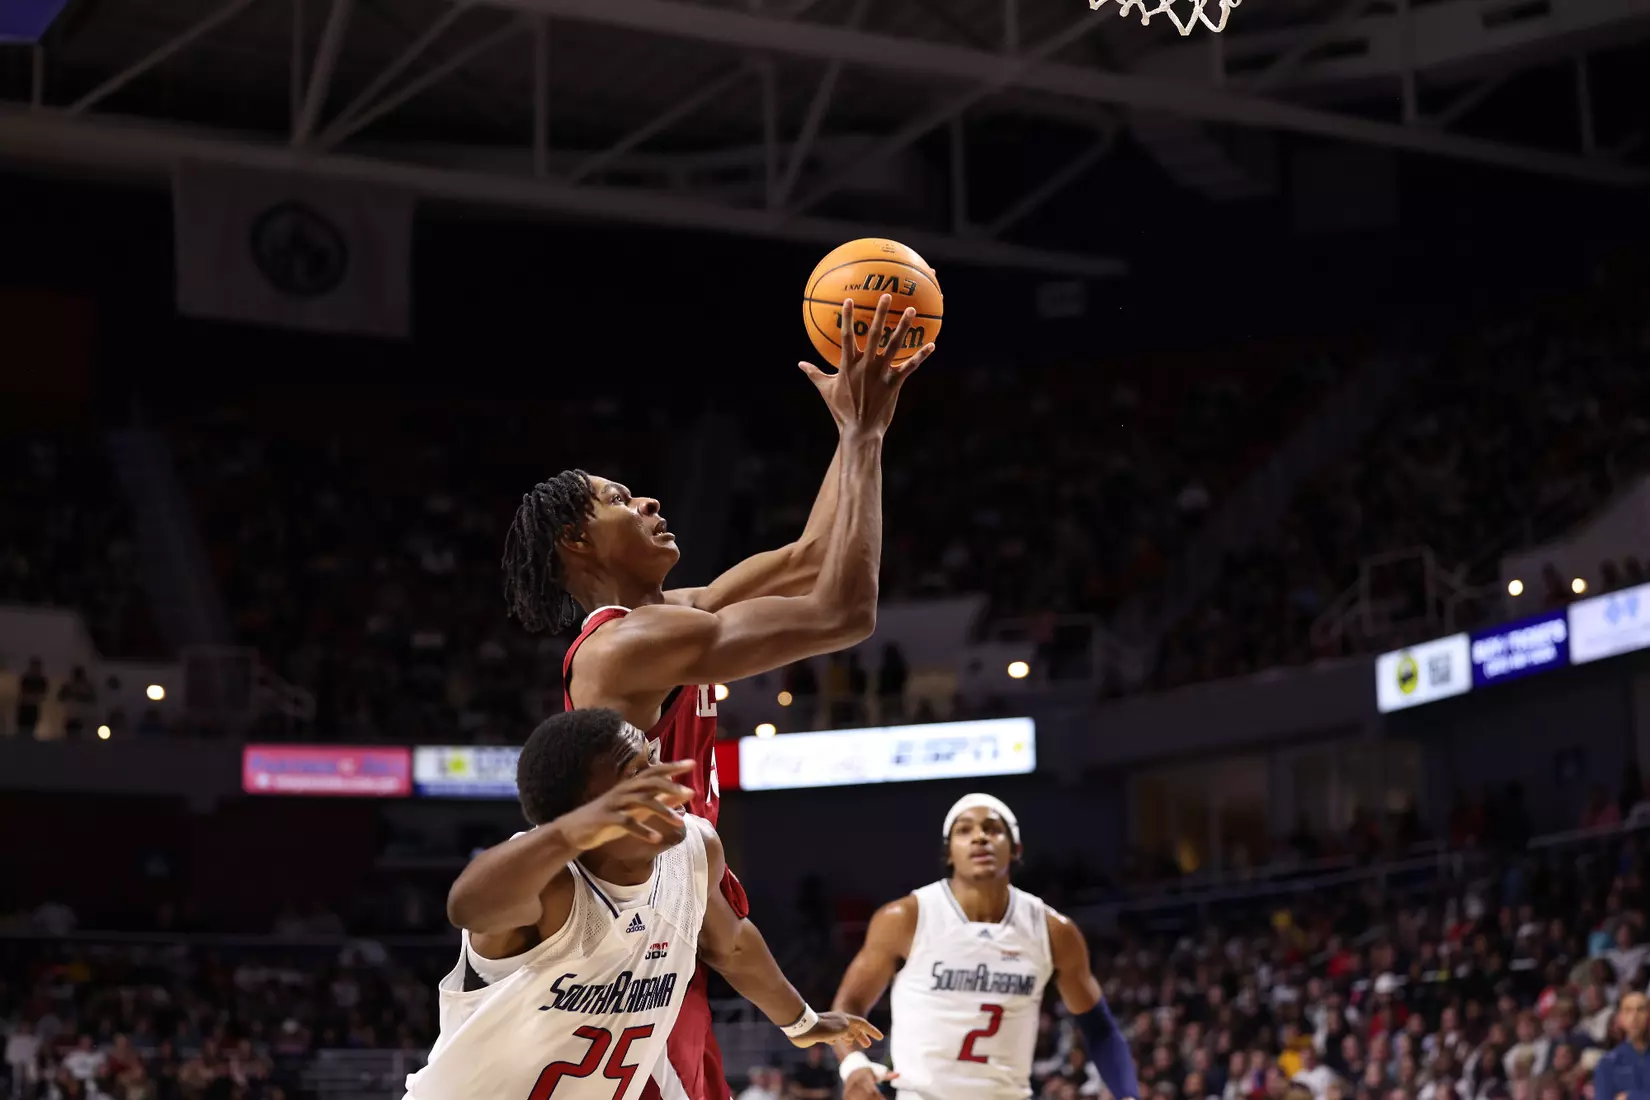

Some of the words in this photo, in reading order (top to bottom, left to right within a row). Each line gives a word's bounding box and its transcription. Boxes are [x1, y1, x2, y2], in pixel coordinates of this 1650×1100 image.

[862, 273, 918, 296] EVO
[625, 924, 646, 934] adidas
[957, 1003, 1004, 1064] 2
[527, 1023, 655, 1100] 25
